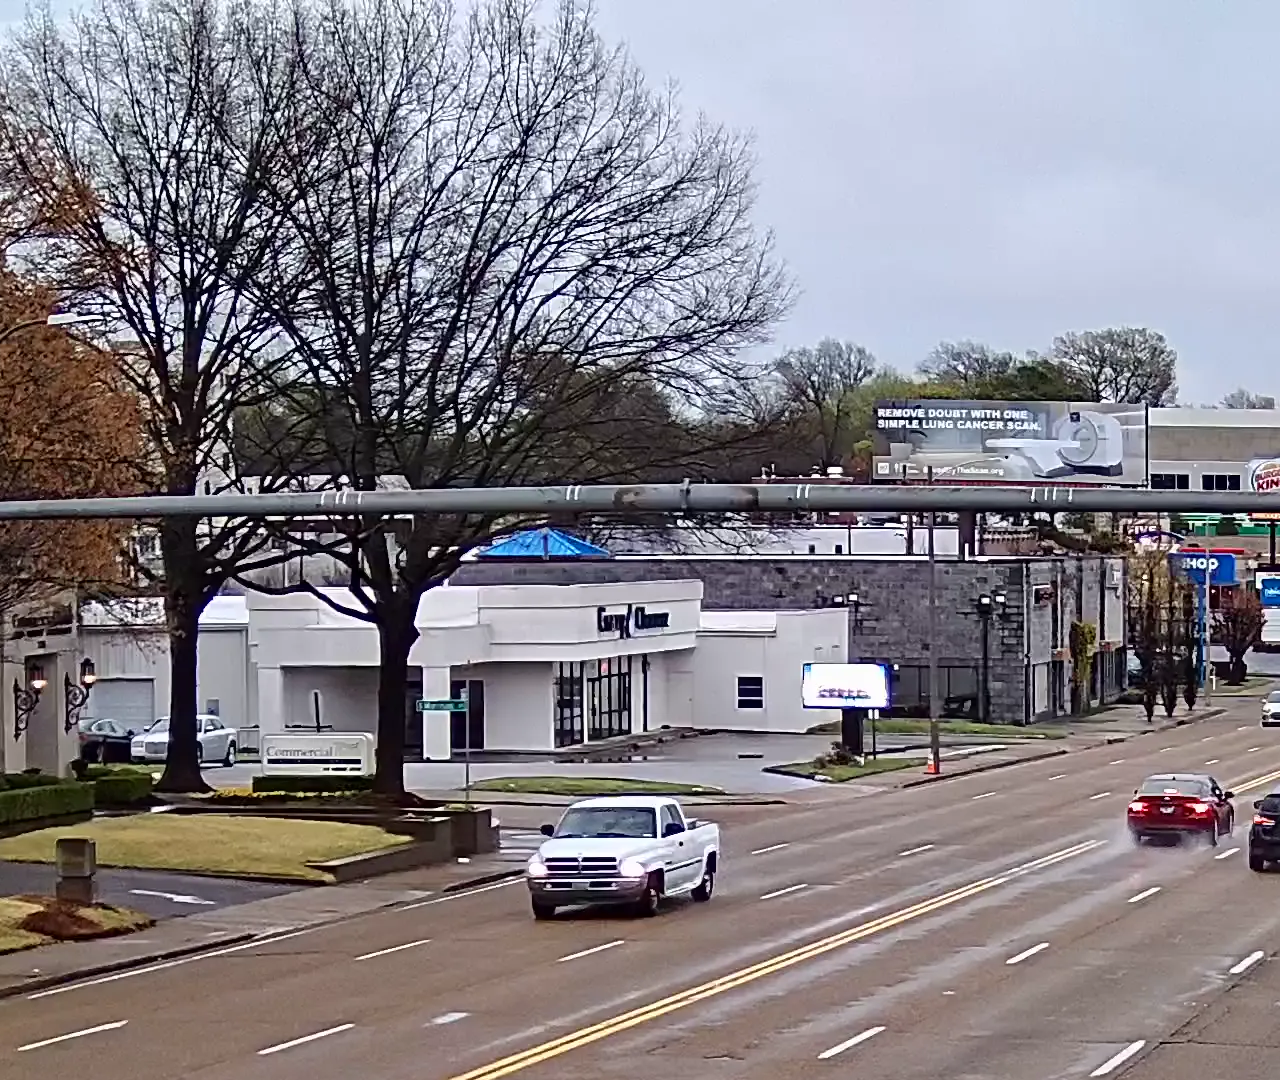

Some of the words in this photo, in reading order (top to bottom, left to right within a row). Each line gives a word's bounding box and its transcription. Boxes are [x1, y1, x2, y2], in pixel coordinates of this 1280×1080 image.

[877, 408, 925, 418] REMOVE
[928, 409, 967, 419] DOUBT
[970, 410, 1000, 420] WITH
[1003, 410, 1029, 420] ONE
[877, 419, 920, 429] SIMPLE
[922, 420, 954, 430] LUNG
[957, 420, 1004, 431] CANCER
[1007, 421, 1042, 432] SCAN.
[266, 746, 333, 757] Commercial
